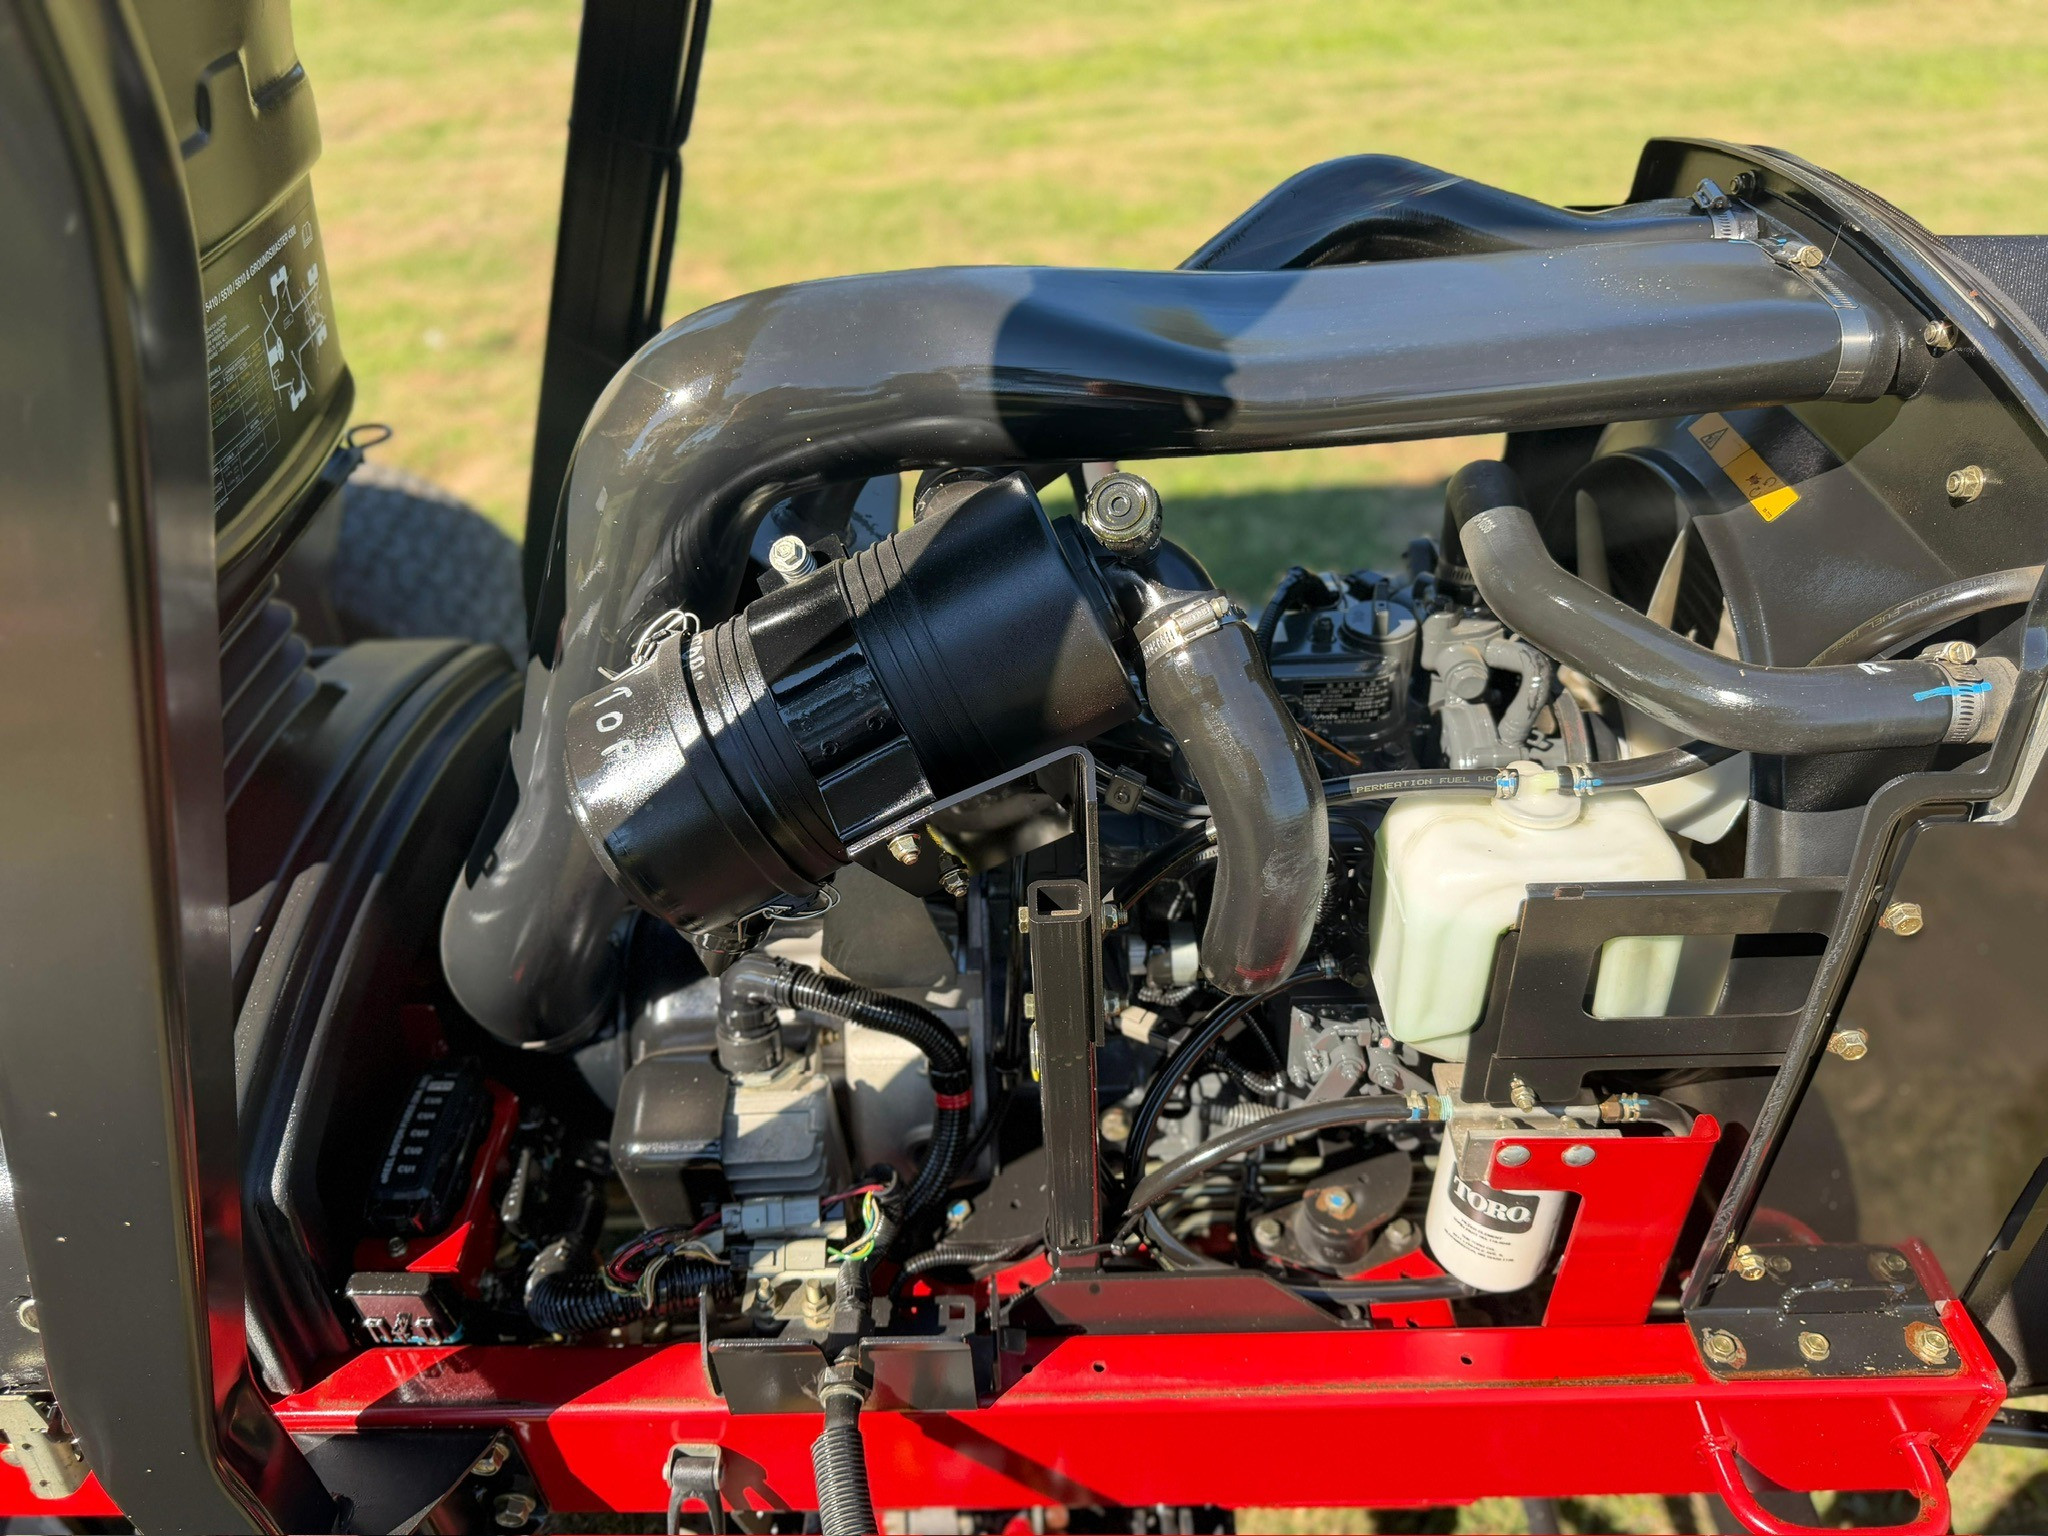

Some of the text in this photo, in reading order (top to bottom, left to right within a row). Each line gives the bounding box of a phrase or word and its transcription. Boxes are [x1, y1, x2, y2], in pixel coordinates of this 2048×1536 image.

[1866, 606, 1902, 628] FUEL
[1831, 631, 1861, 652] HOSE
[1355, 775, 1496, 794] PERMEATION FUEL HO
[397, 1164, 417, 1174] CU1
[1453, 1175, 1531, 1223] TORO
